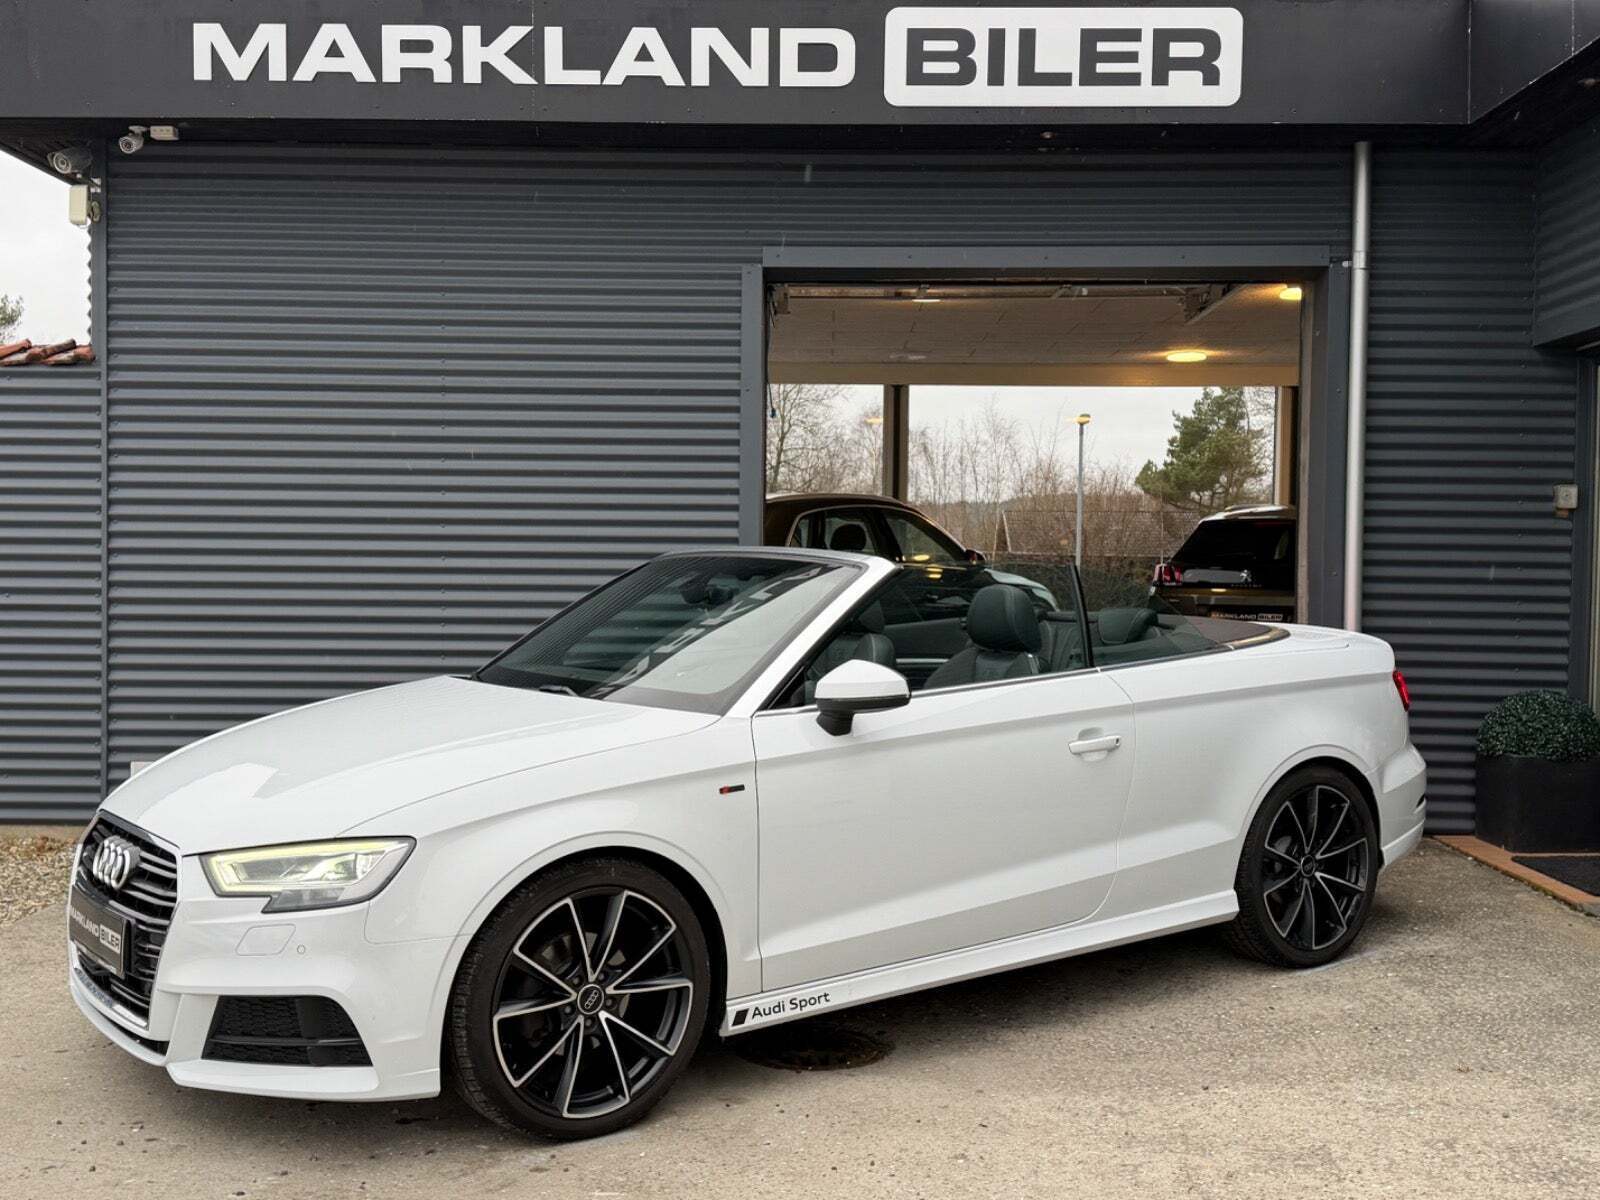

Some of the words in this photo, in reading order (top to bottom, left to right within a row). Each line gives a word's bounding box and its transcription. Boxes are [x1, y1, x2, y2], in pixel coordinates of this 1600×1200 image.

[193, 23, 856, 88] MARKLAND
[905, 27, 1222, 87] BILER
[101, 927, 121, 951] BILER
[751, 1001, 786, 1019] Audi
[789, 992, 831, 1011] Sport
